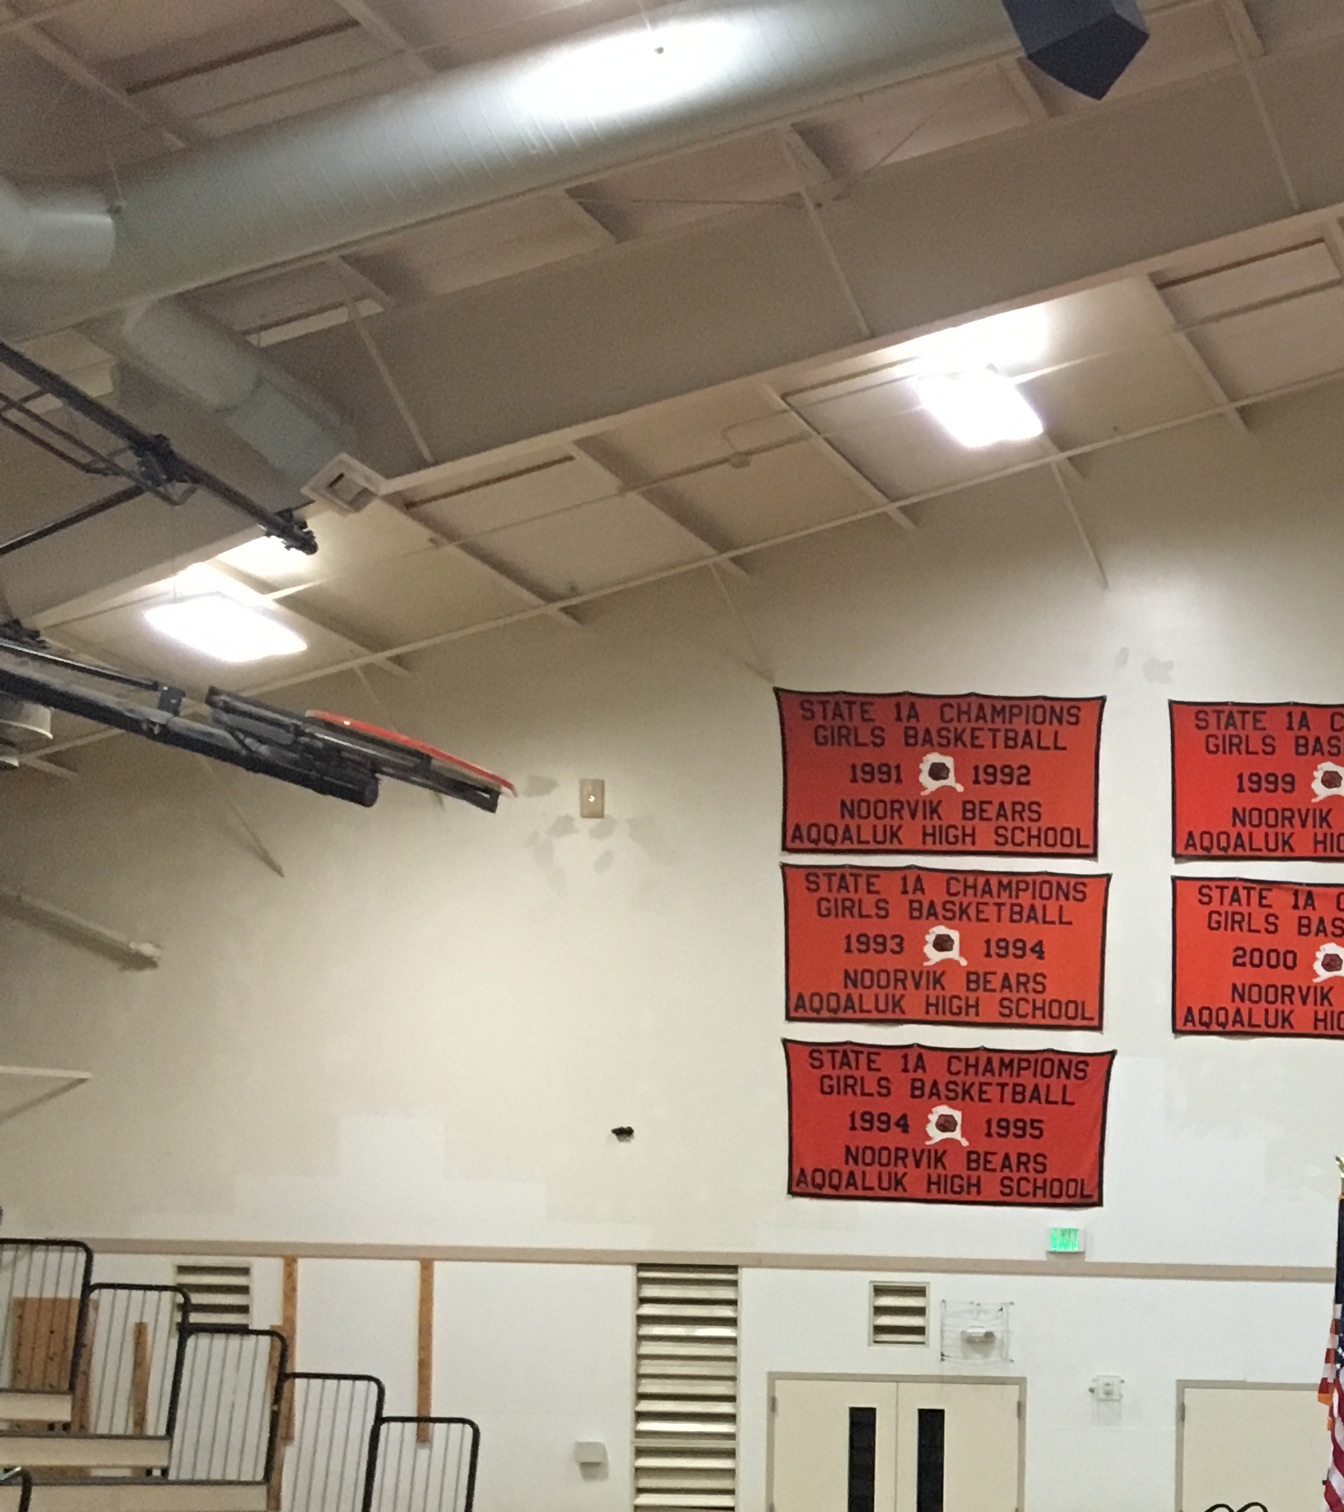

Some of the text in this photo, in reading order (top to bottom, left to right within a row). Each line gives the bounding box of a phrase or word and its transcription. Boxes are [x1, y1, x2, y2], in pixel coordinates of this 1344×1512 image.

[801, 701, 1081, 725] STATE 1A CHAMPIONS
[1195, 710, 1267, 732] STATE
[1286, 711, 1310, 732] 1A
[814, 726, 1067, 751] GIRLS BASKETBALL
[1205, 735, 1276, 755] GIRLS
[850, 763, 1031, 786] 1991 1992
[1237, 773, 1295, 793] 1999
[841, 800, 1042, 822] NOORVIK BEARS
[1232, 808, 1333, 829] NOORVIK
[791, 823, 1089, 848] AQQALUK HIGH SCHOOL
[1185, 831, 1295, 854] AQQALUK
[806, 872, 1087, 901] STATE 1A CHAMPIONS
[1198, 885, 1273, 908] STATE
[1292, 890, 1316, 911] 1A
[816, 897, 1072, 925] GIRLS BASKETBALL
[1208, 910, 1279, 935] GIRLS
[844, 934, 1045, 960] 1993 1994
[1232, 947, 1297, 970] 2000
[844, 969, 1047, 993] NOORVIK BEARS
[794, 992, 1094, 1021] AQQALUK HIGH SCHOOL
[1232, 983, 1334, 1007] NOORVIK
[1184, 1007, 1294, 1029] AQQALUK
[810, 1049, 1089, 1080] STATE 1A CHAMPIONS
[820, 1075, 1075, 1105] GIRLS BASKETBALL
[849, 1111, 1044, 1139] 1994 1995
[844, 1145, 1047, 1173] NOORVIK BEARS
[797, 1168, 1093, 1198] AQQALUK HIGH SCHOOL
